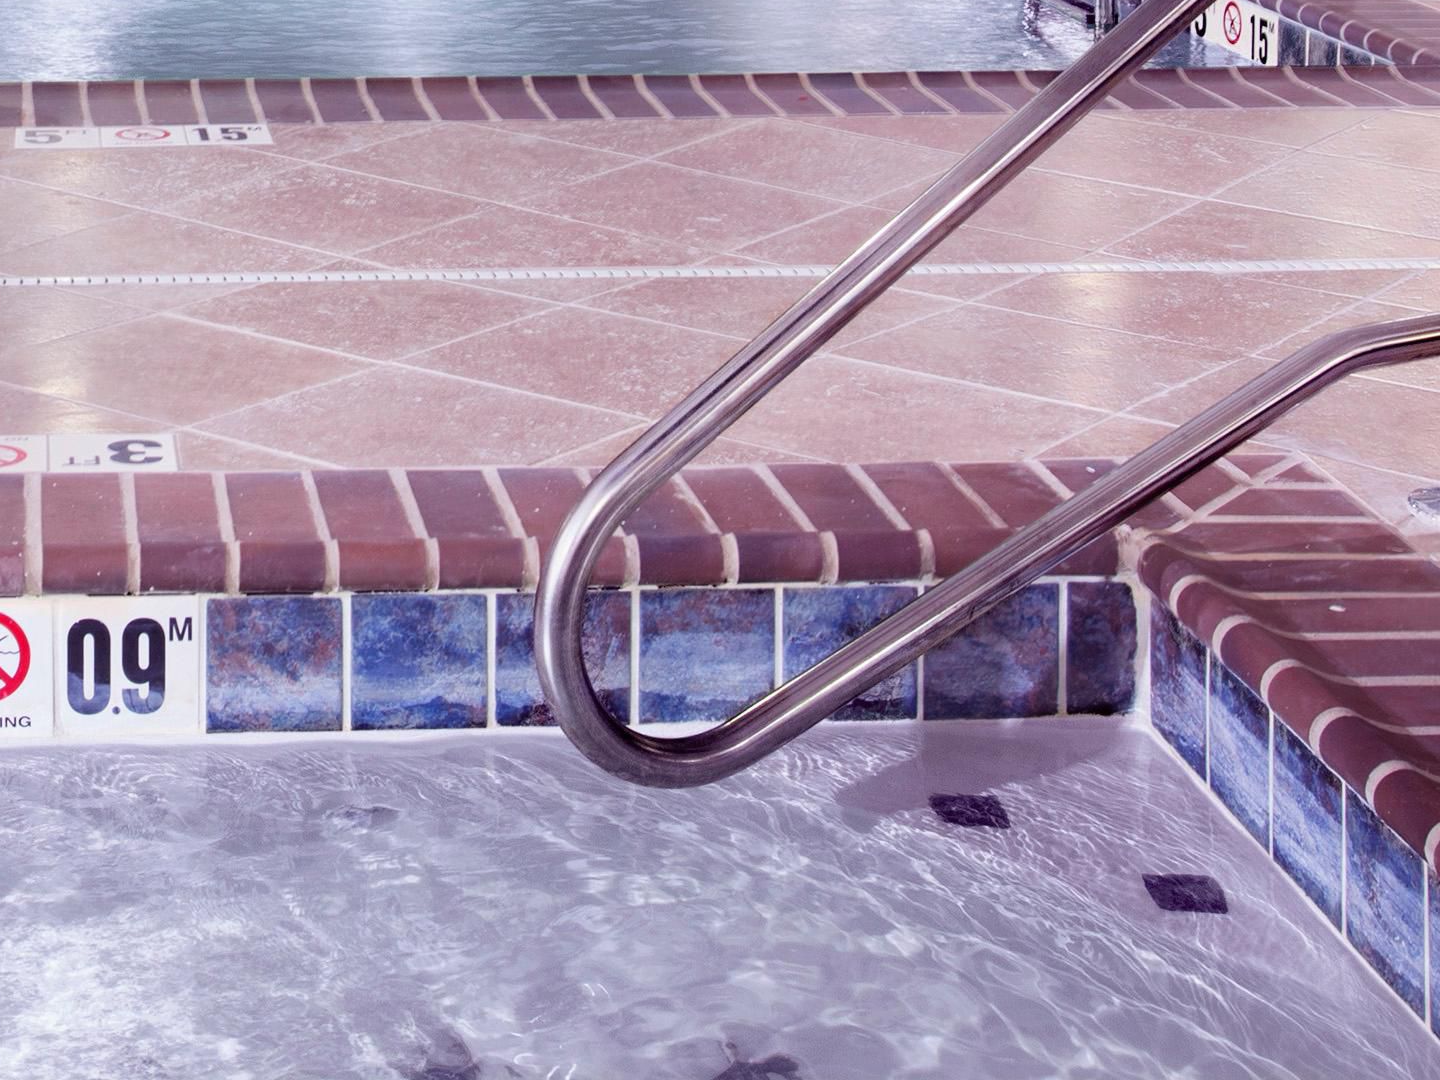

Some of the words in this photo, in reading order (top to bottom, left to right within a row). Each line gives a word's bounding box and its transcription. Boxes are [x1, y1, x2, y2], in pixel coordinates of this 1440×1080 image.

[24, 130, 63, 144] 5
[62, 455, 101, 466] FT
[107, 439, 163, 465] 3
[67, 618, 166, 716] 0.9
[169, 617, 193, 642] M
